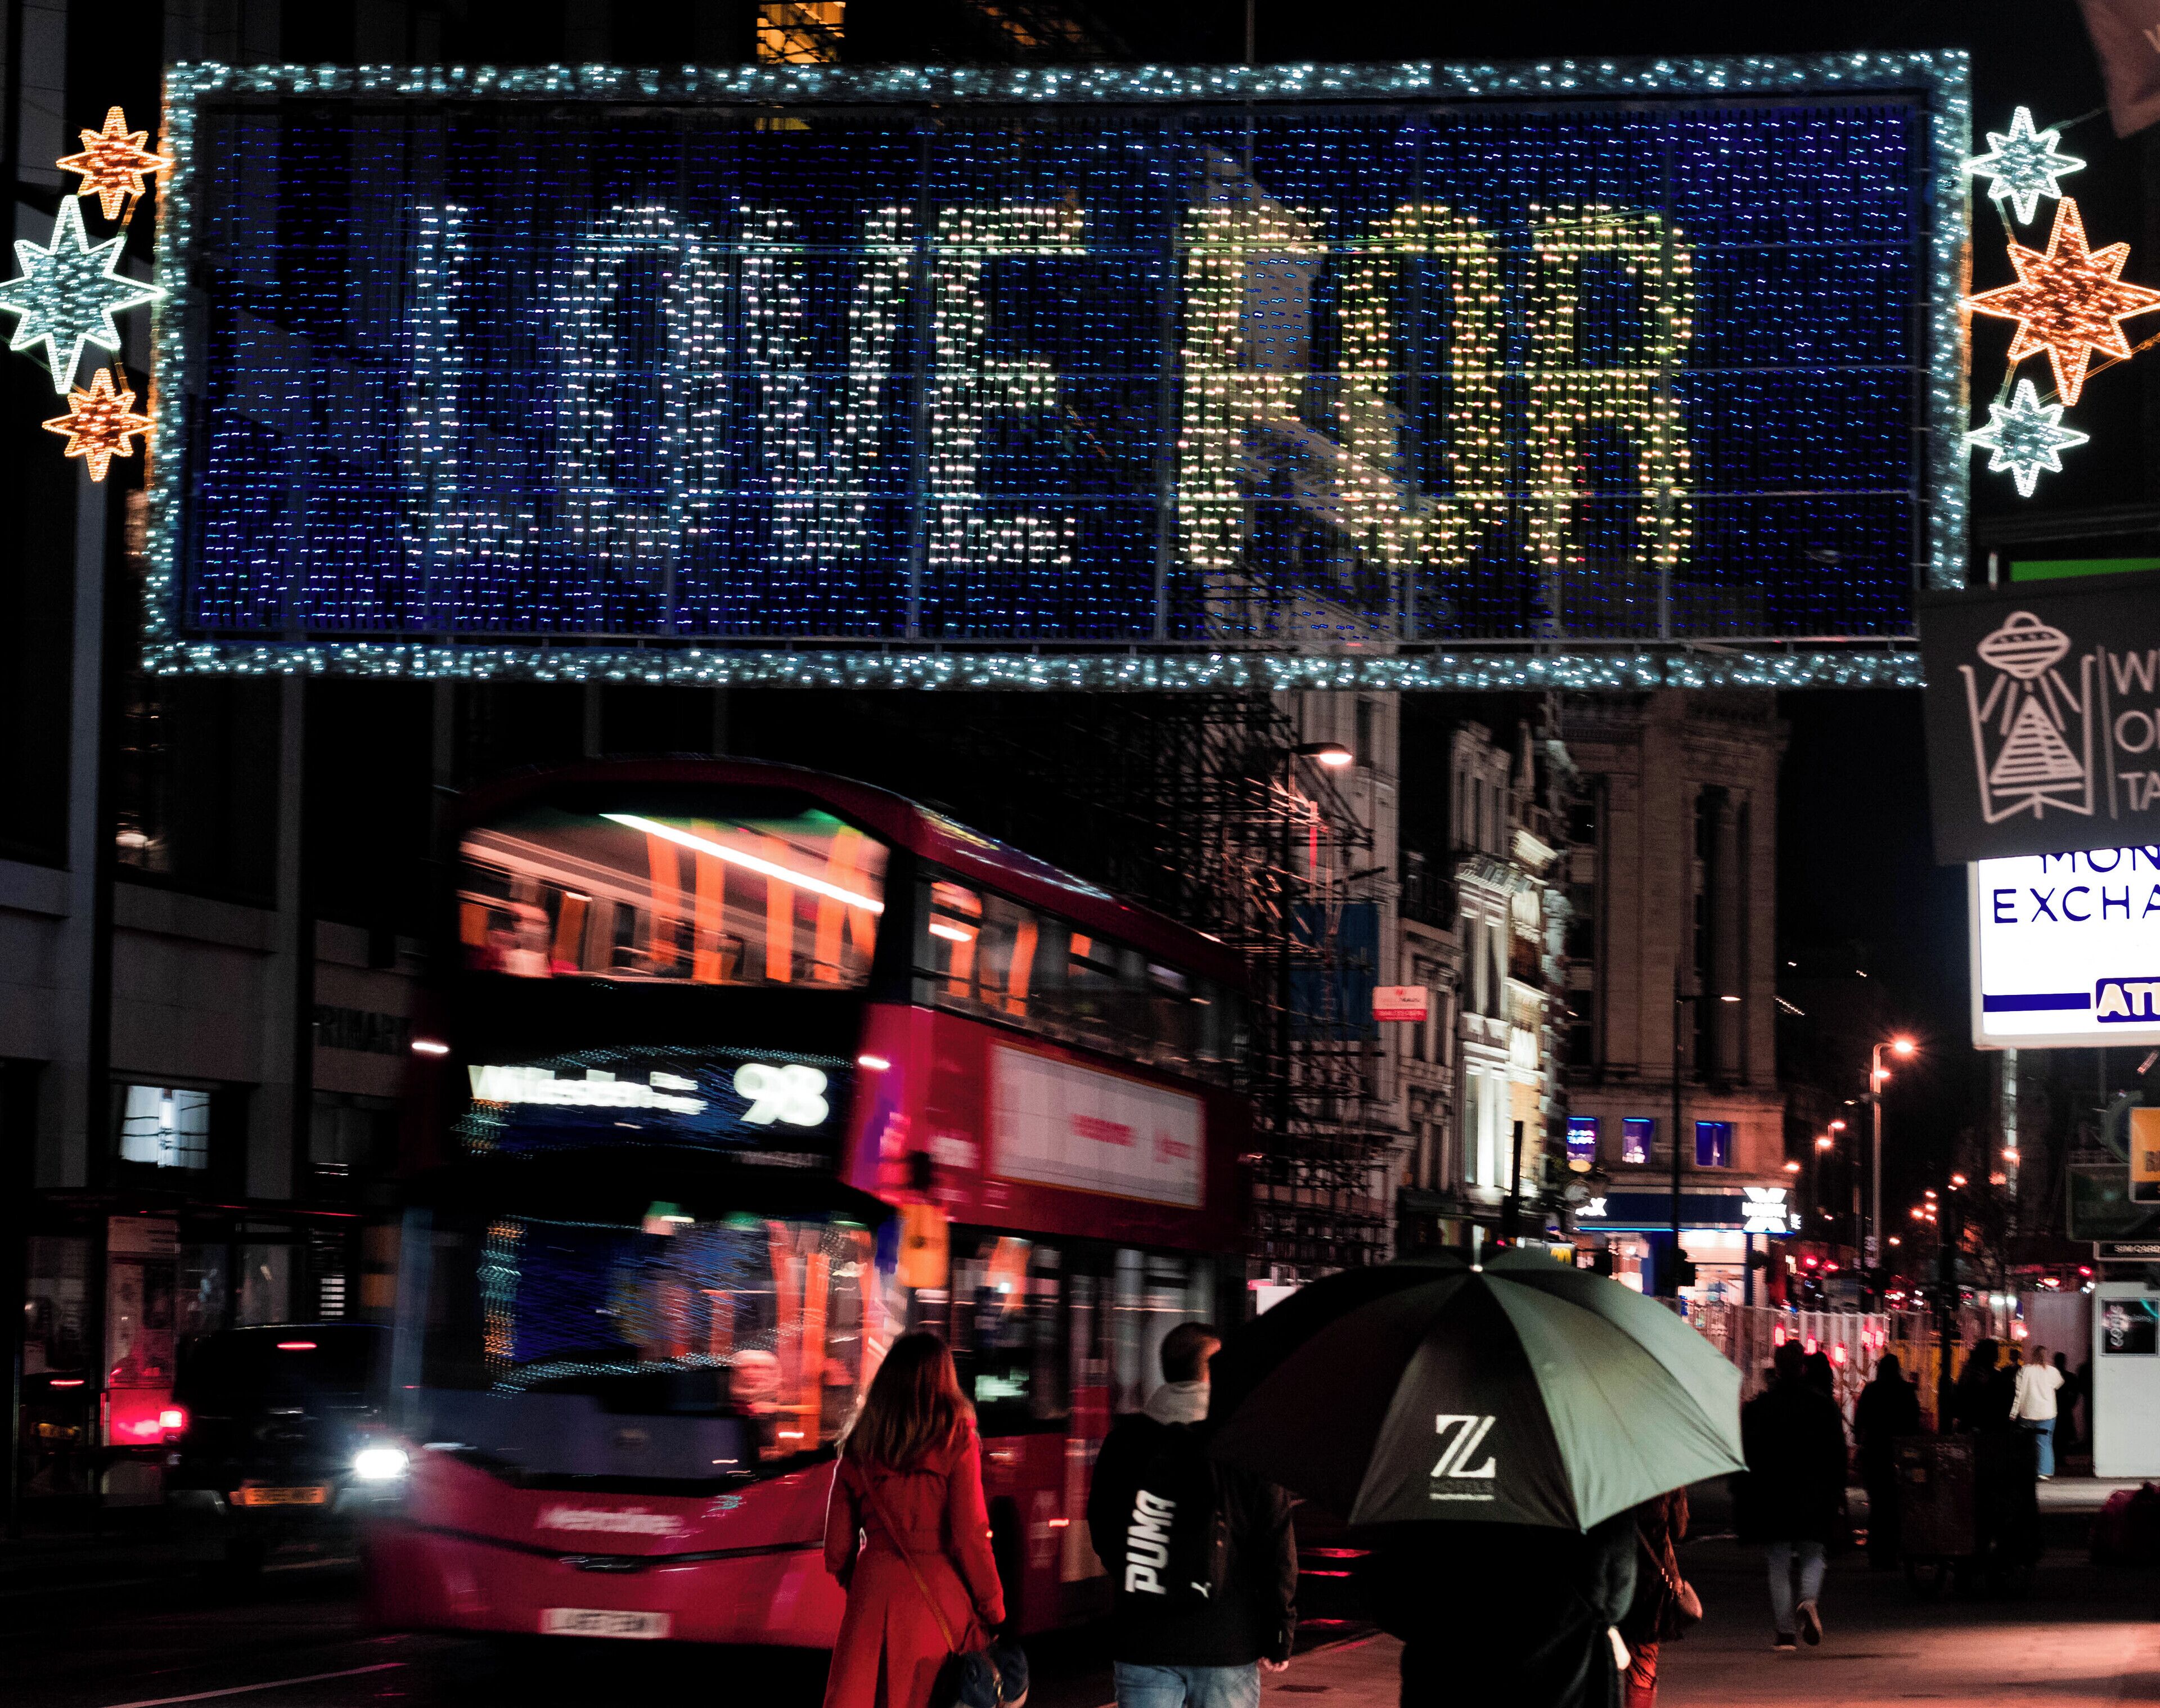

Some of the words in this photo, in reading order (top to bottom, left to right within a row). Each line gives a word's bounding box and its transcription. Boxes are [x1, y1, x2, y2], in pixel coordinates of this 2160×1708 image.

[403, 204, 1087, 564] LOVE
[1177, 204, 1695, 564] FOR
[2108, 649, 2160, 696] W
[2114, 707, 2160, 754] O
[1994, 884, 2160, 923] EXCHA
[733, 1063, 830, 1126] 98
[1430, 1414, 1496, 1478] Z
[1125, 1489, 1176, 1595] PUMA
